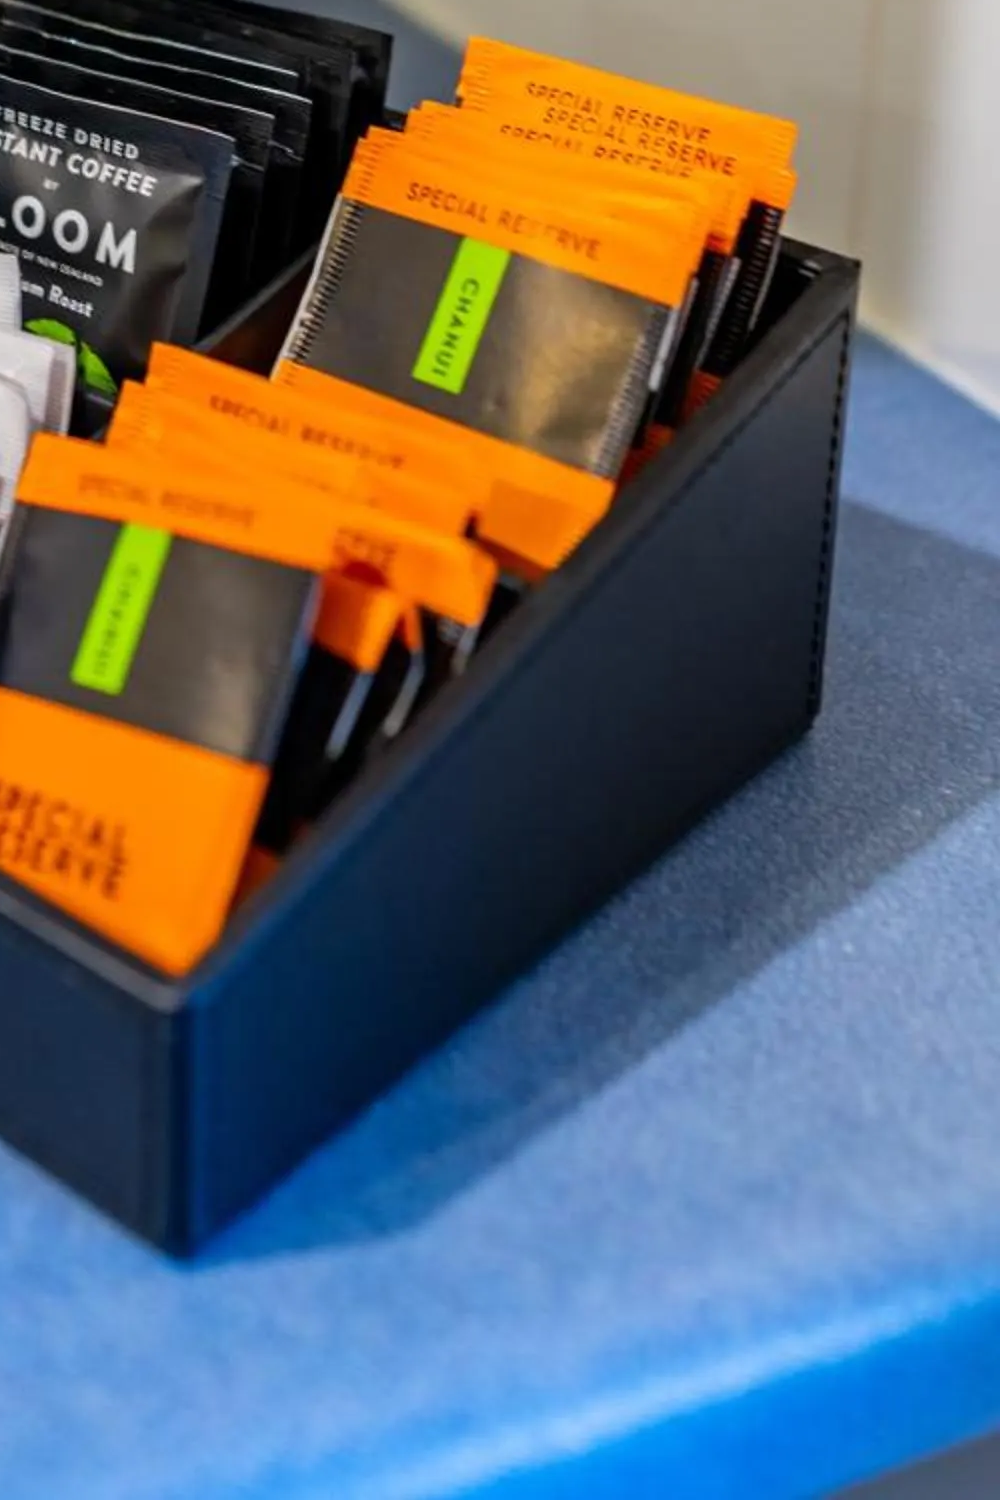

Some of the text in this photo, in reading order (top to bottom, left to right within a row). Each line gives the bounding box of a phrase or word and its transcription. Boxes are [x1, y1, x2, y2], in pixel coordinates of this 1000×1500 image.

[526, 81, 711, 144] SPECIAL RESERVE
[73, 128, 139, 160] DRIED
[638, 131, 738, 177] RESERVE
[66, 153, 158, 197] COFFEE
[406, 182, 601, 262] SPECIAL RERVE
[431, 278, 480, 377] CHANUI
